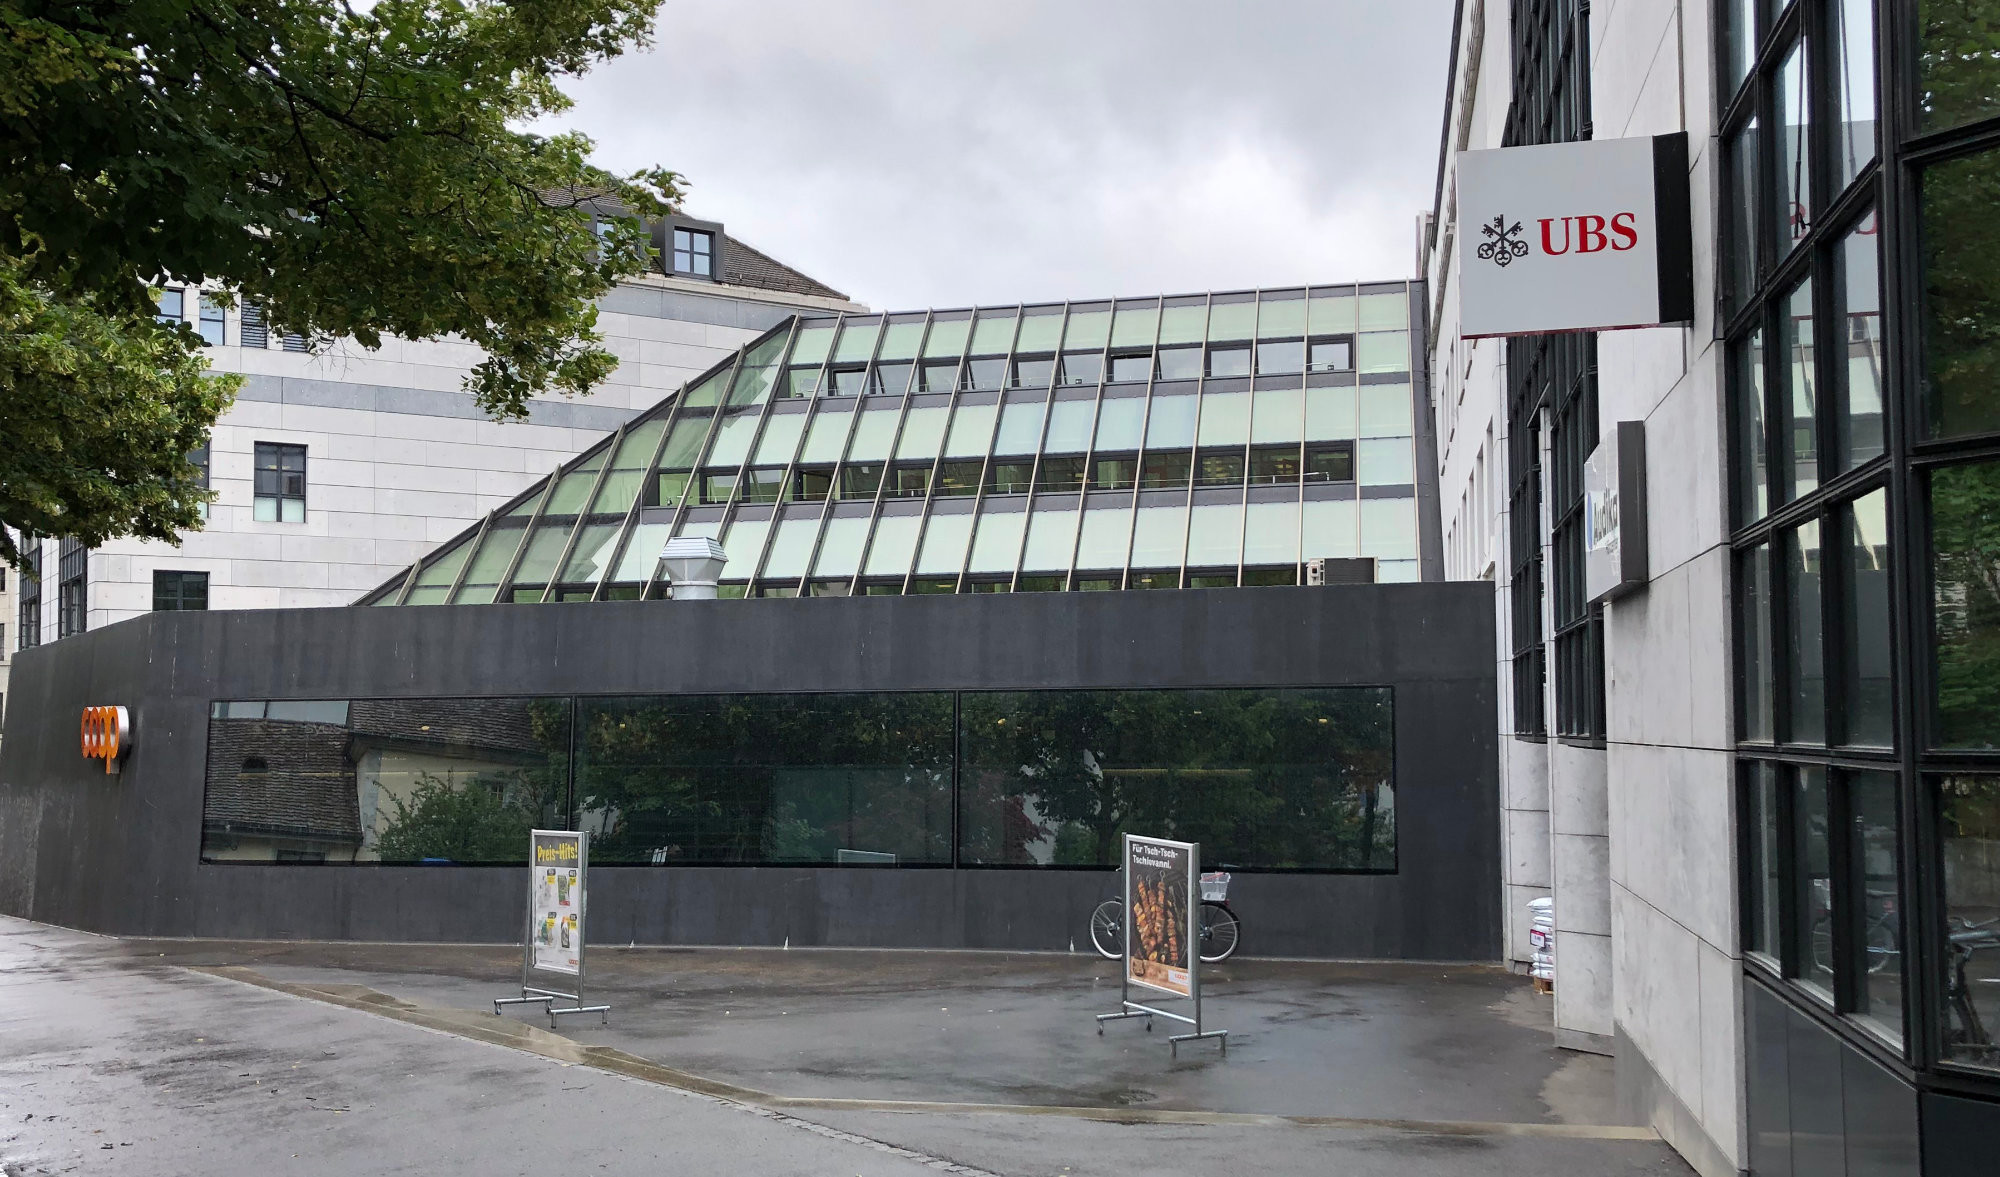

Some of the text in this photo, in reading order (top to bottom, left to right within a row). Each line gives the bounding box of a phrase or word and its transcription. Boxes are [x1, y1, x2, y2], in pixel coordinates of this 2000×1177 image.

[1537, 212, 1638, 256] UBS
[537, 841, 578, 862] Preis-Hits!
[1132, 843, 1178, 859] Für Tsch-Tsch-
